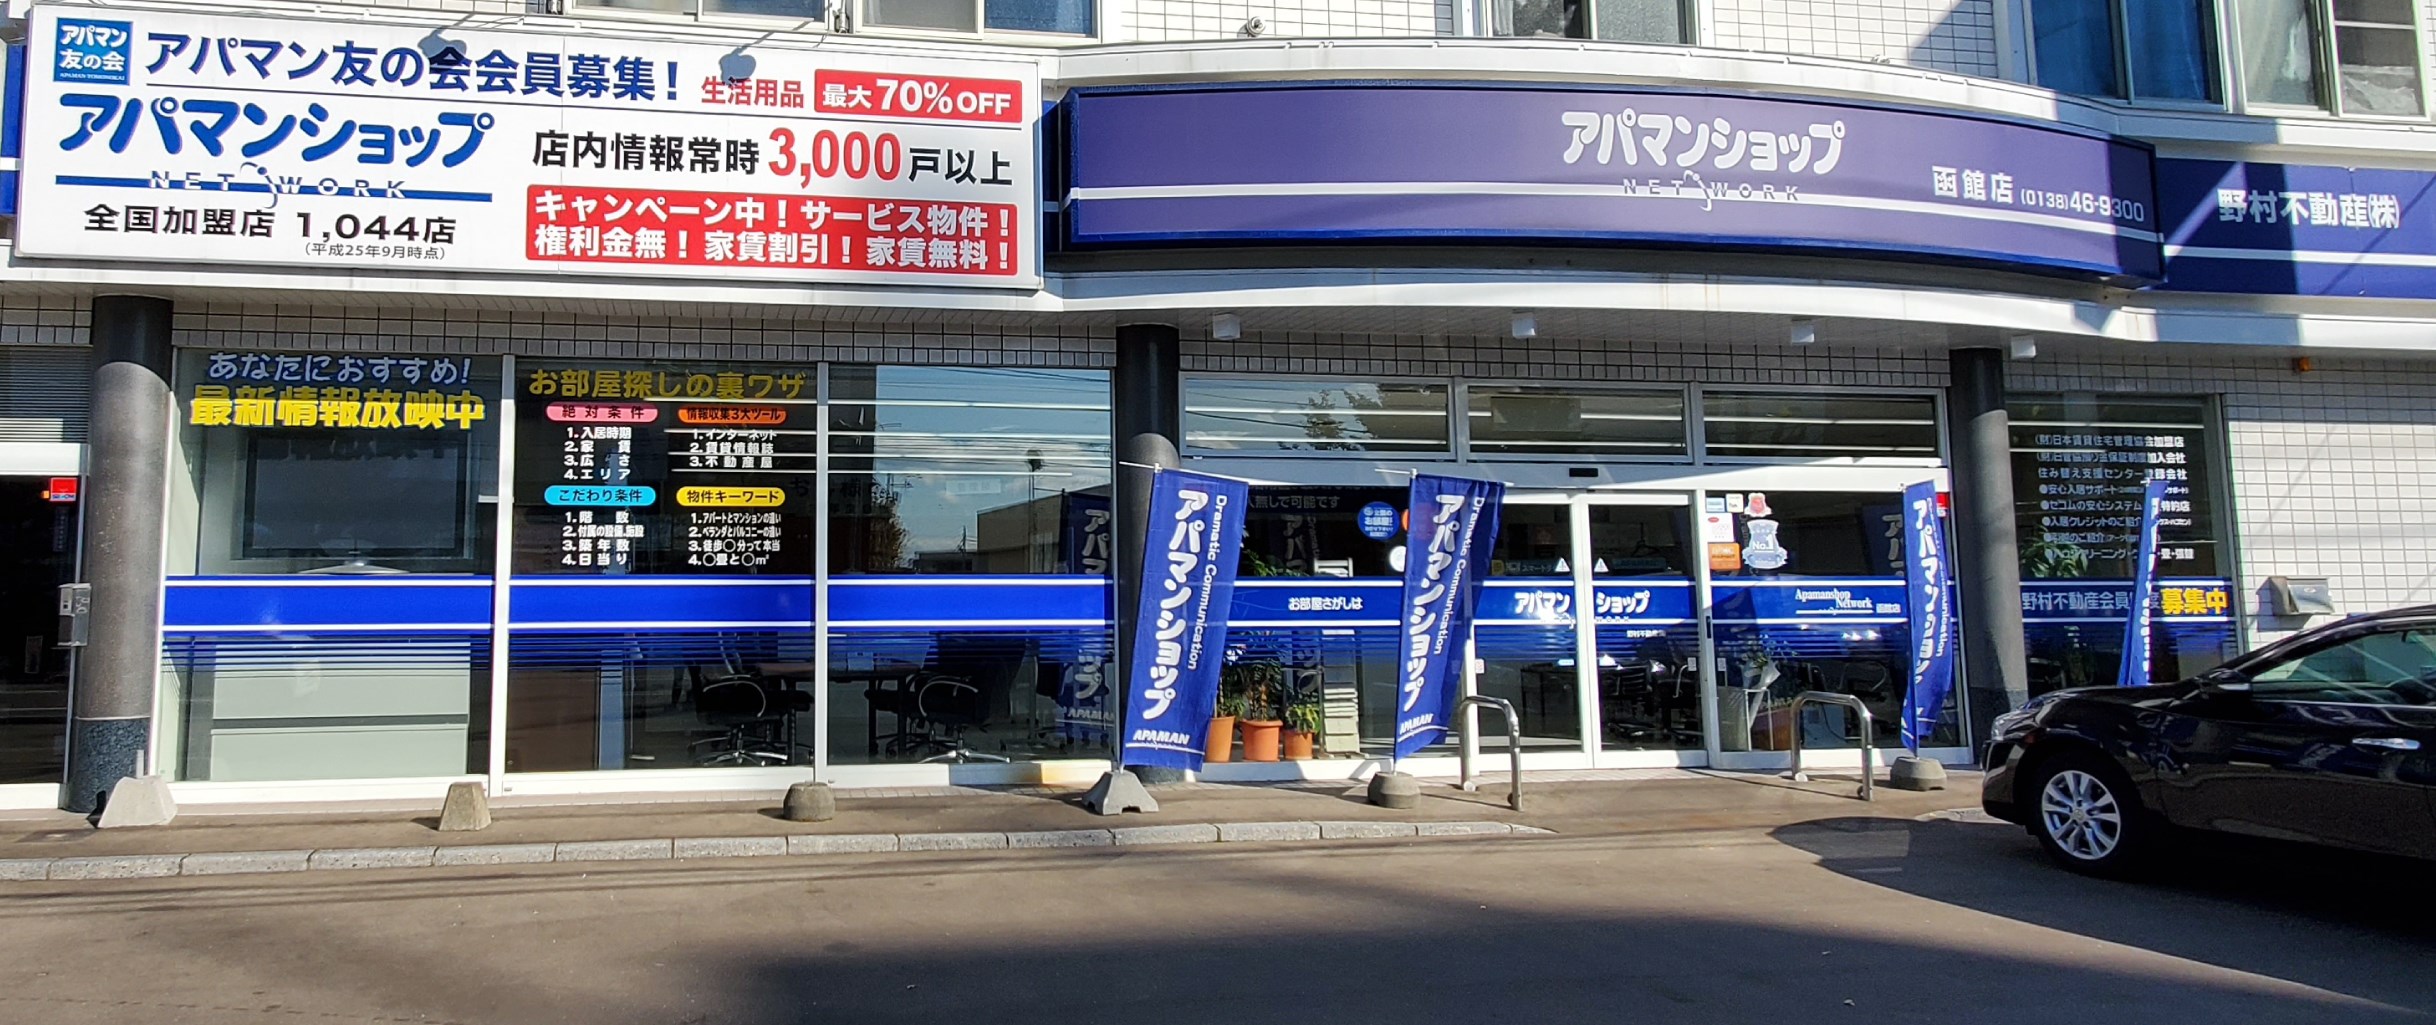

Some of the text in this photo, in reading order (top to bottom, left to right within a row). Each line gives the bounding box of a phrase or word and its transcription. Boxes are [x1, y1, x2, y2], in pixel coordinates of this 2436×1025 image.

[60, 25, 128, 47] アパマン
[59, 48, 126, 72] 友の会
[701, 76, 804, 108] 生活用品
[59, 93, 495, 169] アパマンショップ
[1562, 108, 1845, 174] アパマンショップ
[1932, 166, 2013, 204] 函館店
[84, 204, 456, 245] 全国加盟店 1,044店
[529, 369, 806, 399] お部屋探しの裏ワザ
[190, 385, 486, 430] 最新情報放映中
[559, 488, 642, 503] こだわり条件
[687, 489, 779, 503] 物件キーワード
[1187, 494, 1228, 671] Dramatic Communication
[1795, 588, 1851, 602] Apamanshop
[1142, 489, 1209, 720] アパマンショップ
[1288, 597, 1363, 611] お部屋さがしは
[1404, 494, 1466, 712] アパマンショップ
[1133, 729, 1190, 745] APAMAN
